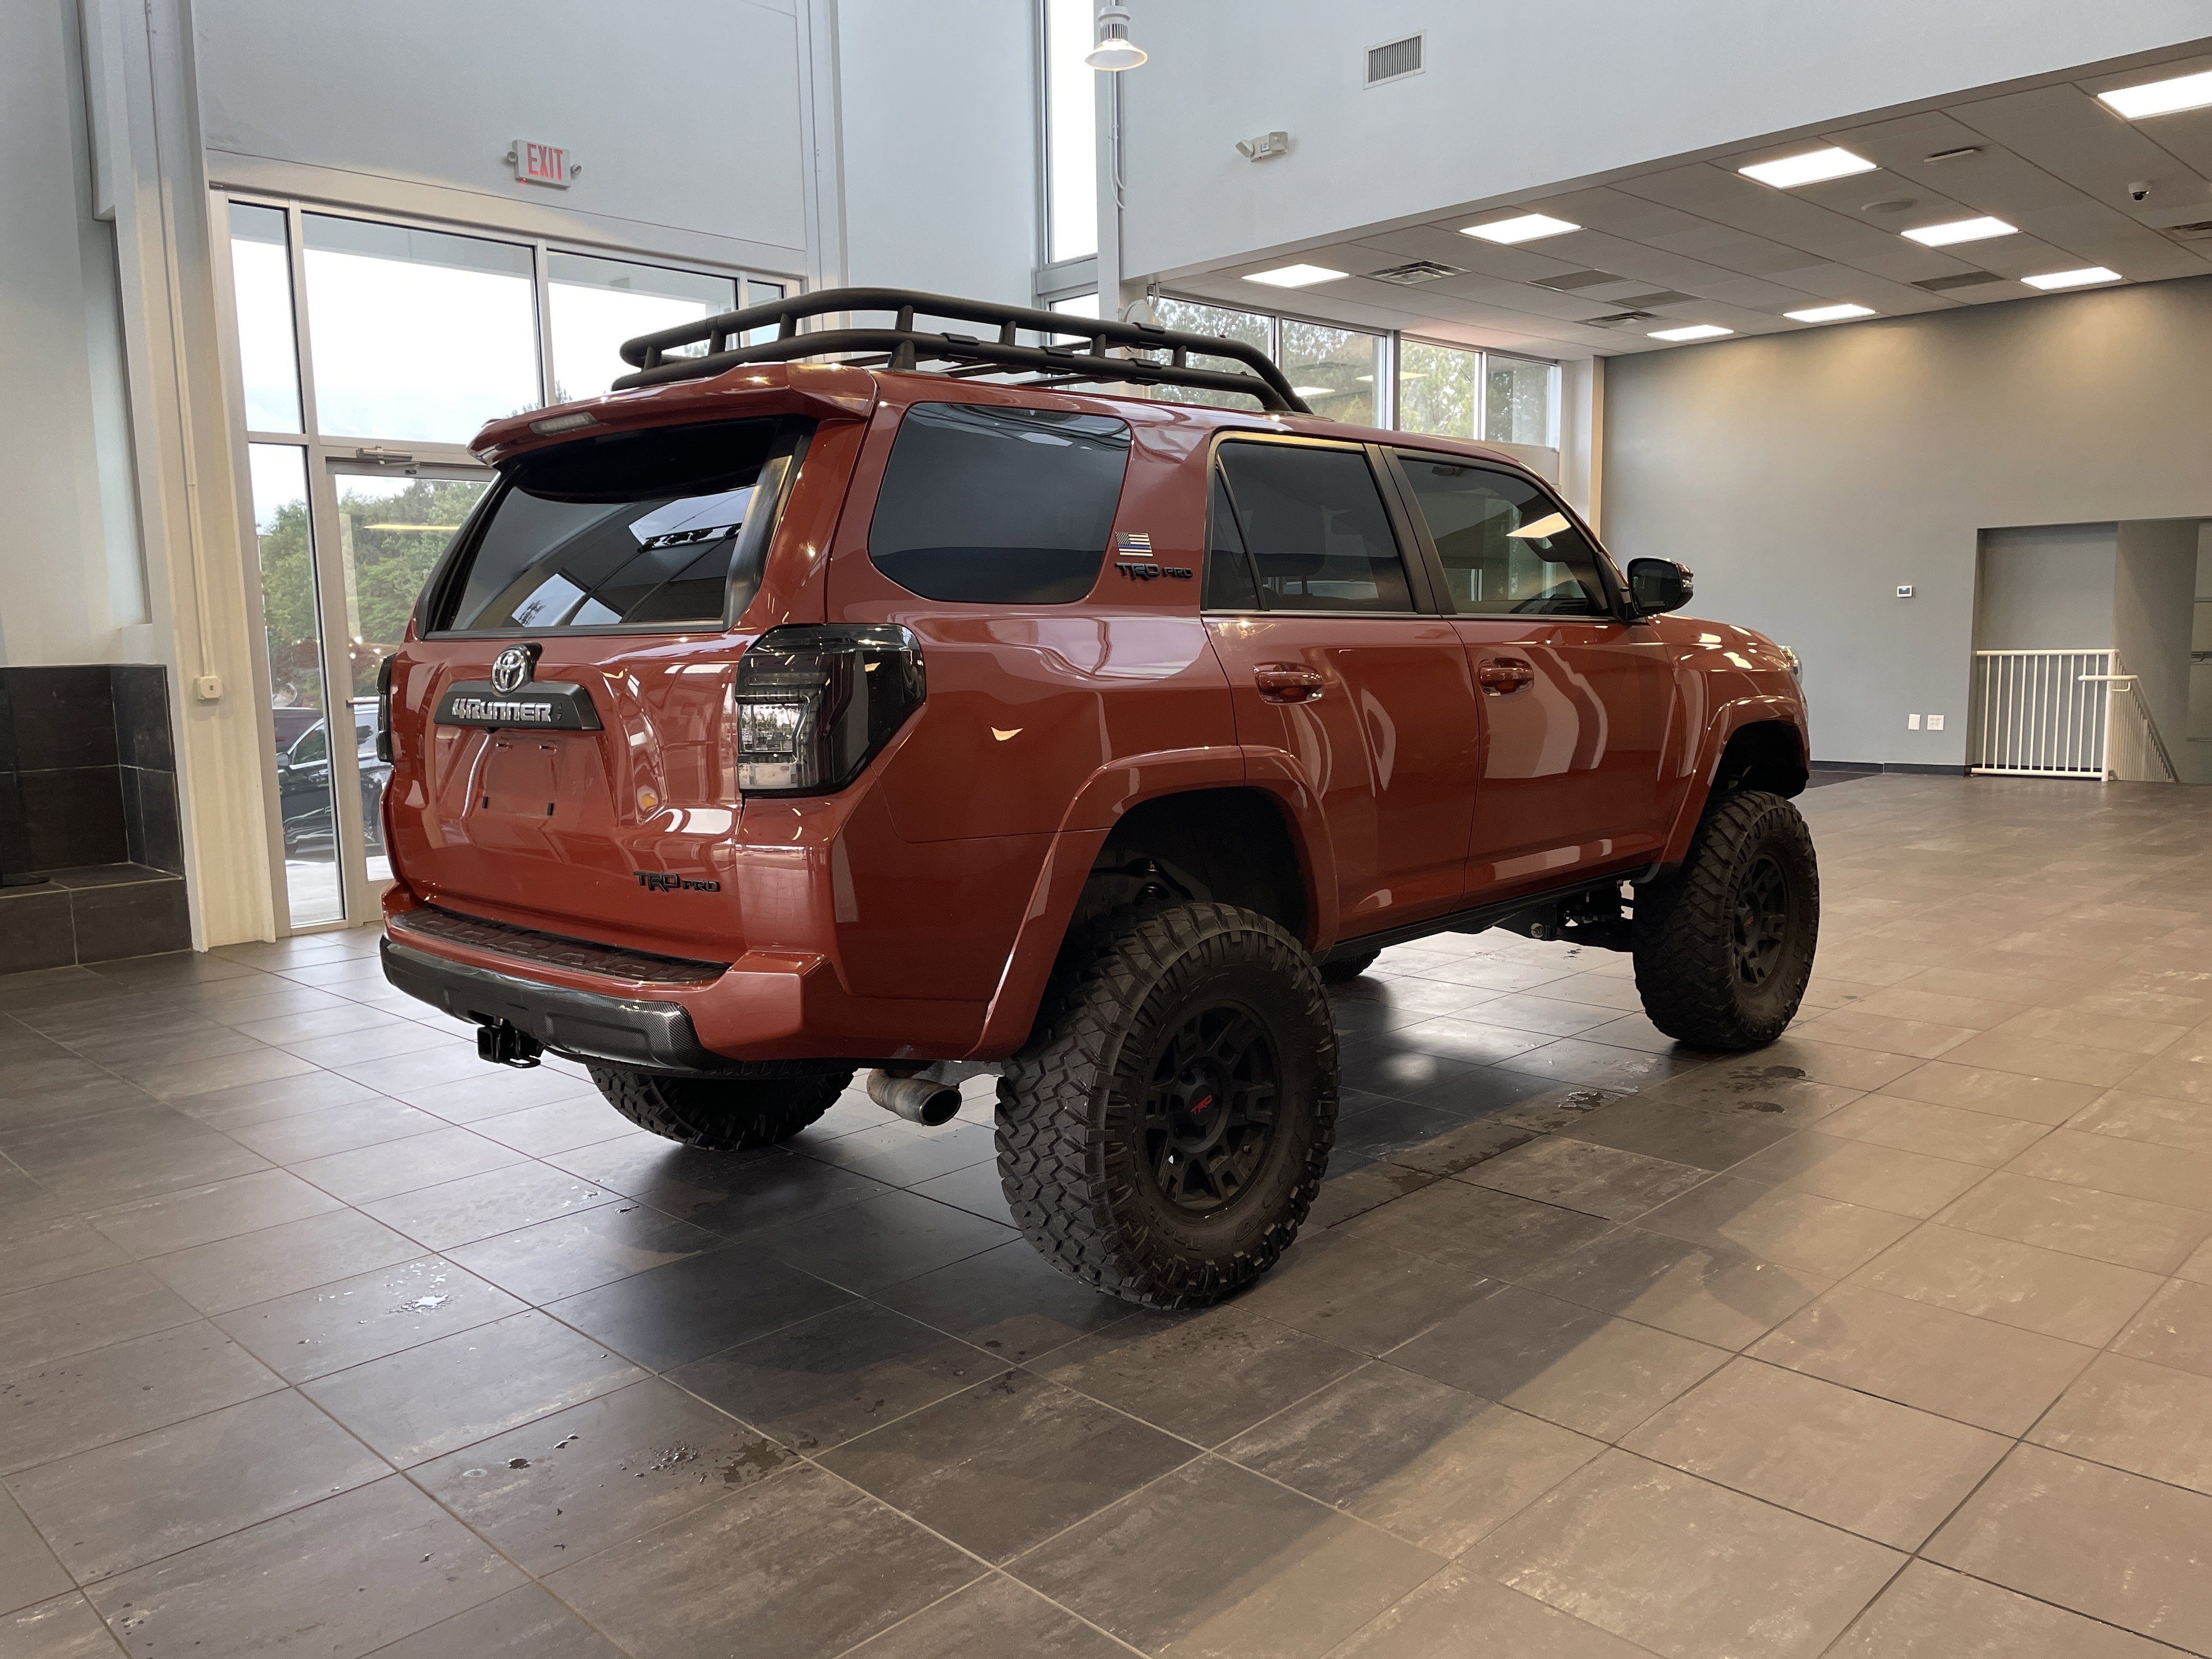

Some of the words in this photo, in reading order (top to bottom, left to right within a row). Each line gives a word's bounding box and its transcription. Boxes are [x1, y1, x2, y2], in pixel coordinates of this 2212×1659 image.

[527, 143, 563, 180] EXIT
[1115, 562, 1161, 581] TRD
[1162, 567, 1194, 579] PRO
[452, 698, 552, 723] 4RUNNER
[633, 870, 680, 893] TRD
[682, 878, 721, 892] PRO
[1190, 1094, 1212, 1115] TRD
